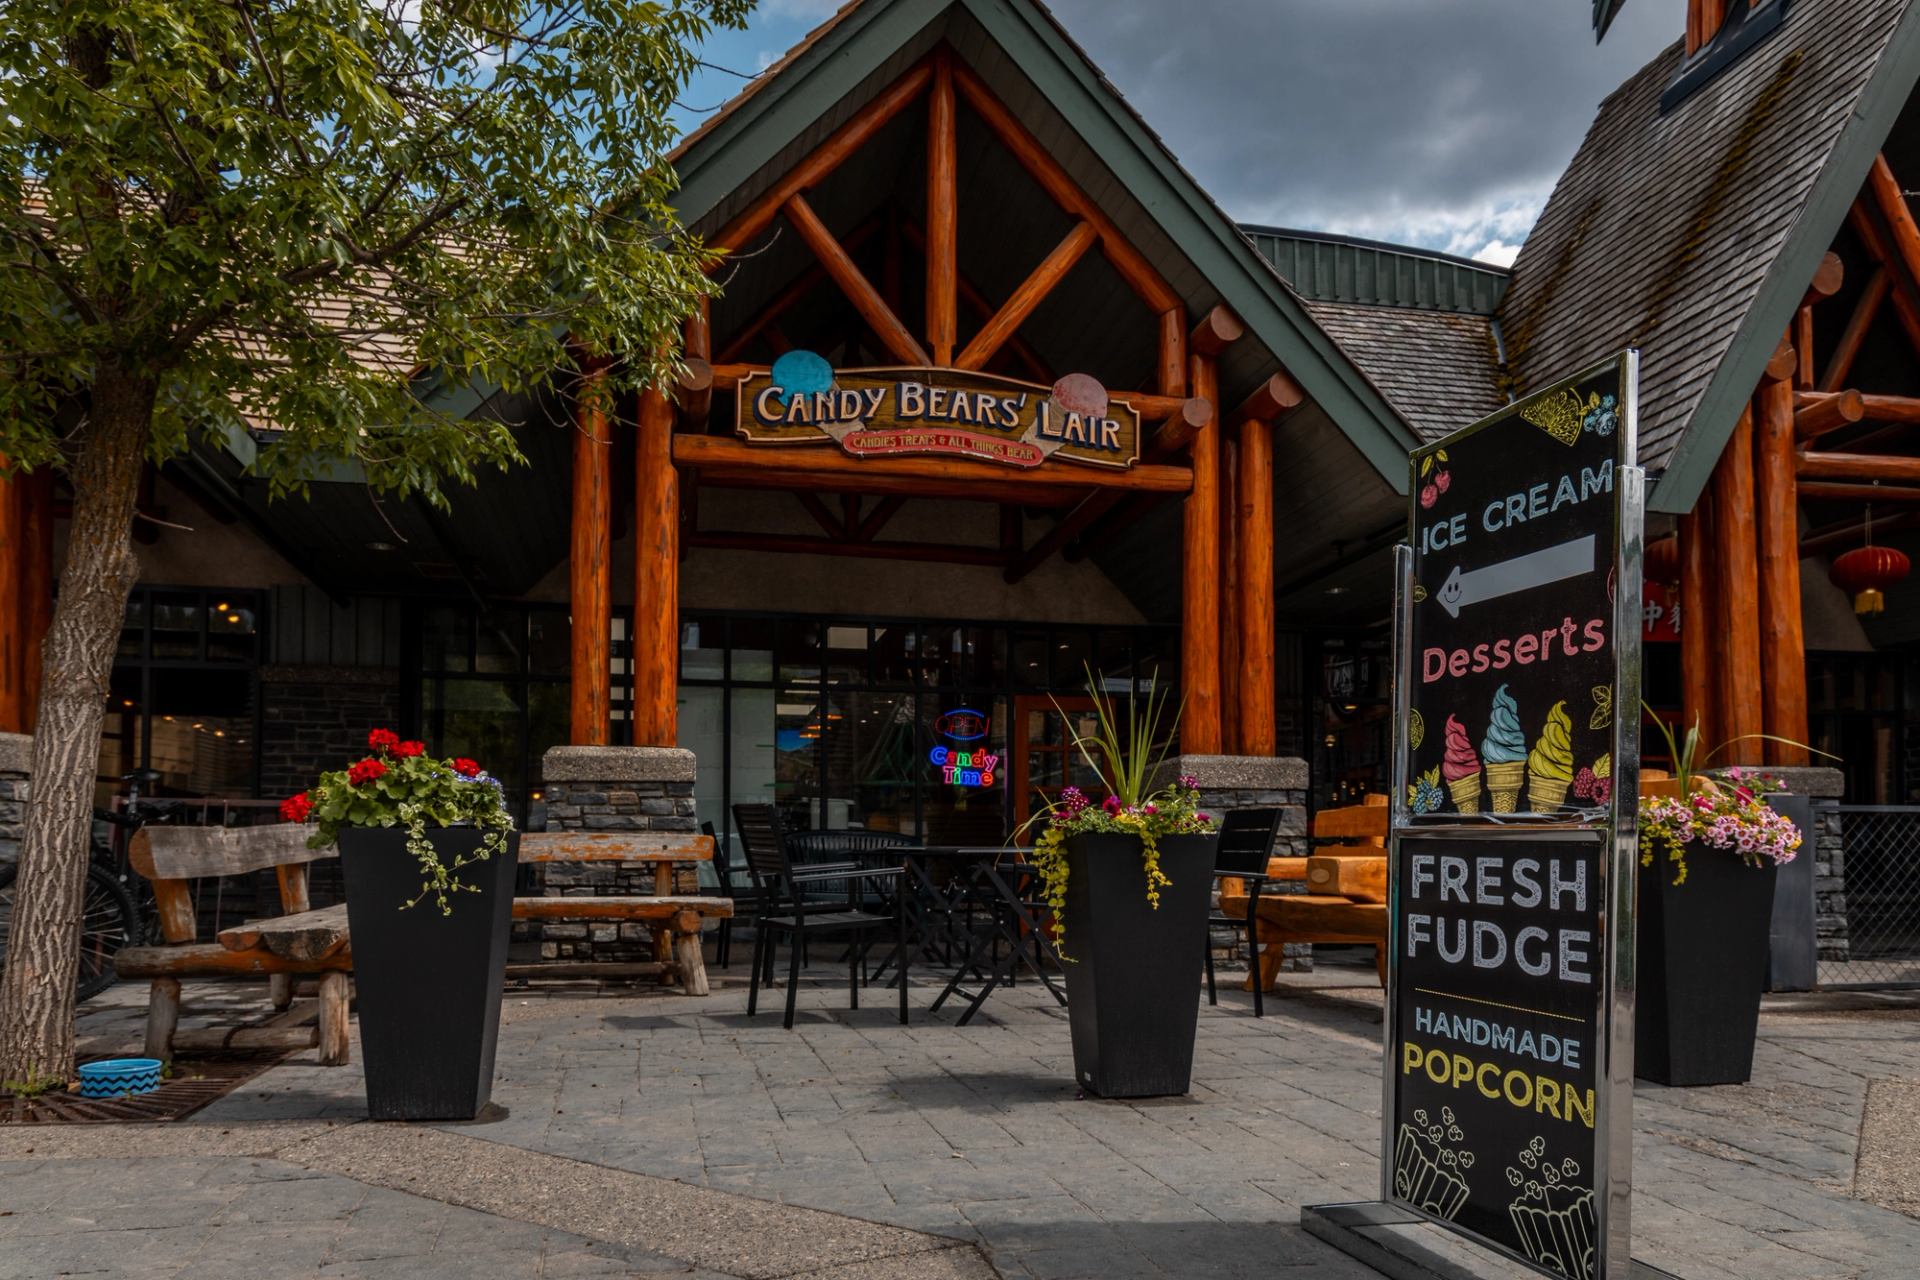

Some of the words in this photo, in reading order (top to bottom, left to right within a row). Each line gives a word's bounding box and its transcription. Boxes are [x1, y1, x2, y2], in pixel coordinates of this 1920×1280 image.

[756, 386, 886, 424] CANDY
[900, 381, 1027, 428] BEARS'
[1040, 401, 1121, 449] LAIR
[852, 436, 897, 448] CANDIES
[899, 434, 936, 446] TREATS
[939, 436, 945, 445] &
[949, 436, 966, 448] ALL
[970, 438, 1004, 456] THINGS
[1007, 446, 1034, 460] BEAR
[1421, 512, 1467, 556] ICE
[1482, 459, 1614, 533] CREAM
[1423, 616, 1605, 684] Desserts
[935, 715, 990, 737] OPEN
[930, 746, 998, 773] Candy
[943, 765, 994, 787] Time
[1411, 854, 1587, 912] FRESH
[1407, 913, 1592, 984] FUDGE
[1415, 1007, 1581, 1069] HANDMADE
[1403, 1041, 1595, 1129] POPCORN
